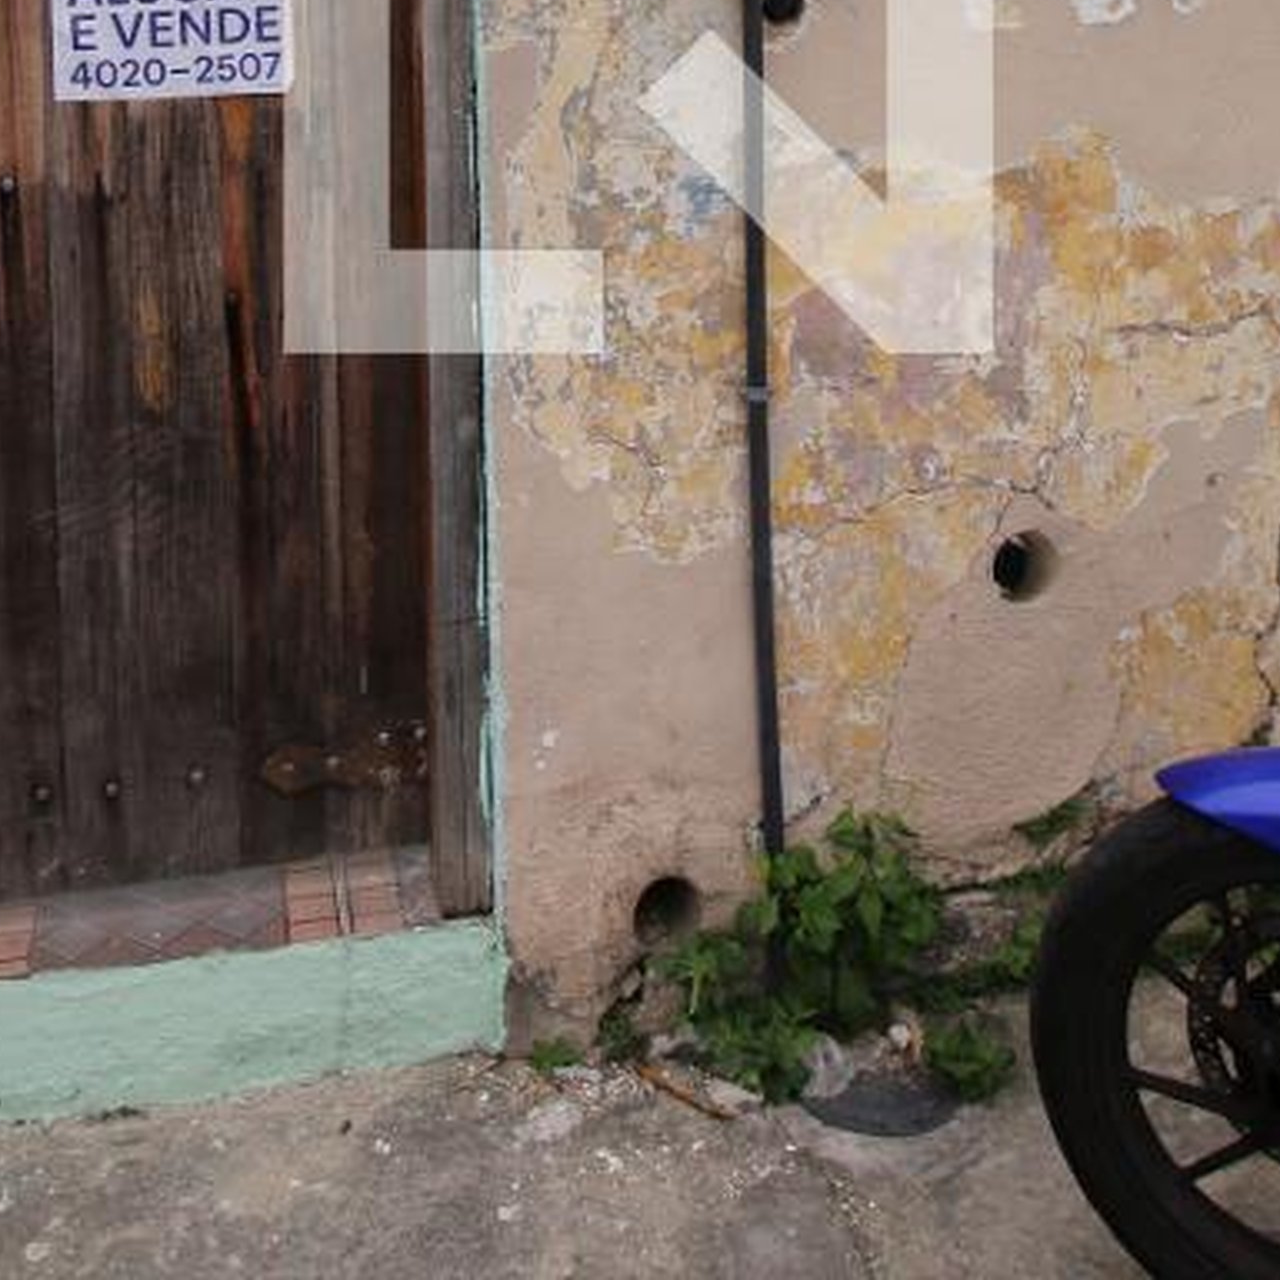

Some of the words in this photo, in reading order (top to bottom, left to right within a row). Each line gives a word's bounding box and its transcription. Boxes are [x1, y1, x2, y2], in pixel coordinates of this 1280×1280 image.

[71, 14, 99, 51] E
[111, 6, 282, 49] VENDE
[70, 52, 282, 90] 4020-2507
